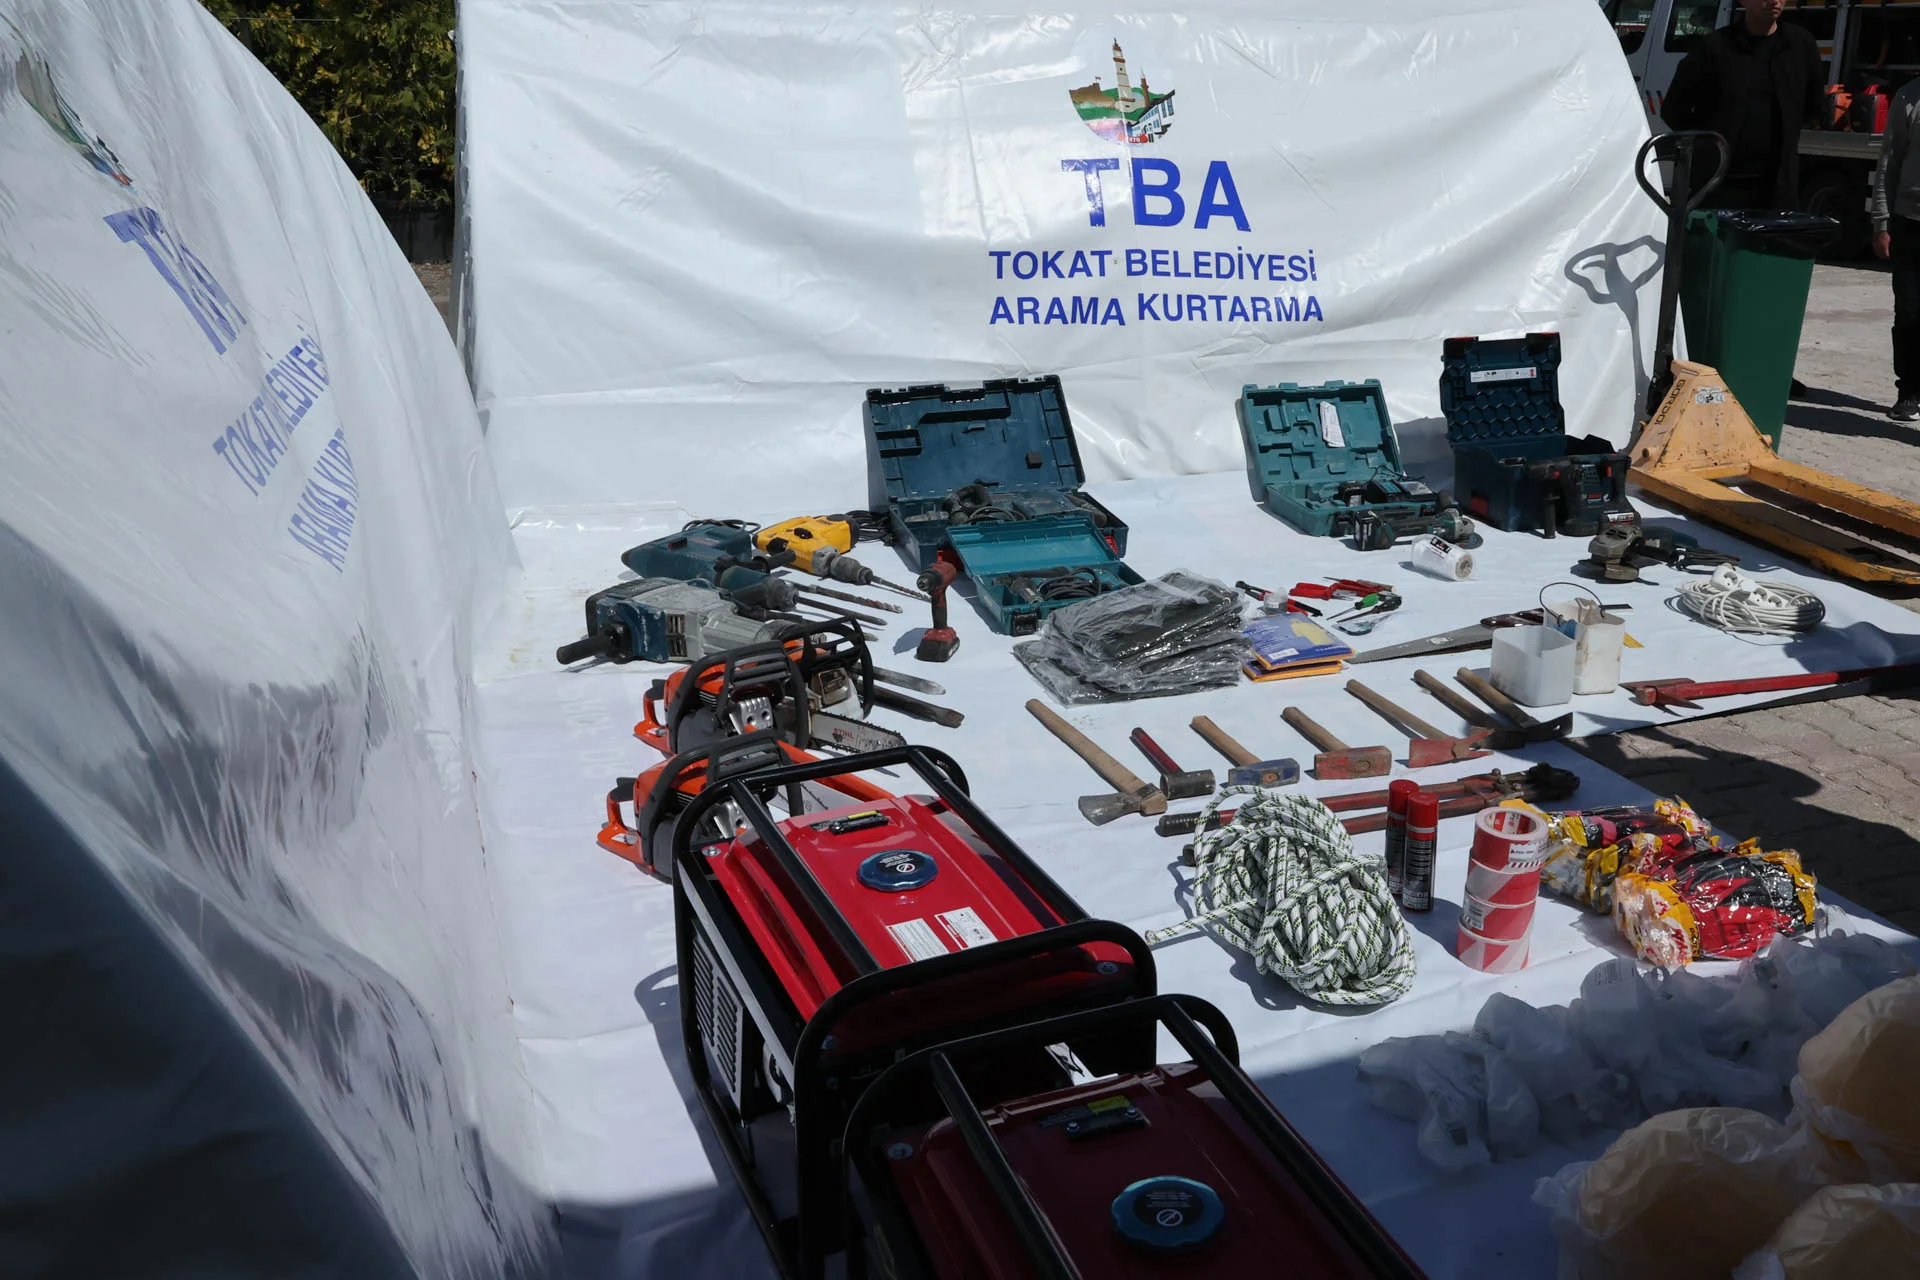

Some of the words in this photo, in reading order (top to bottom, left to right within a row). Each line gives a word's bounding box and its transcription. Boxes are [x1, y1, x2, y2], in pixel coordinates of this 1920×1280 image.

[1061, 157, 1251, 232] TBA
[989, 249, 1113, 280] TOKAT
[1125, 246, 1318, 281] BELEDİYESİ
[989, 295, 1126, 326] ARAMA
[1137, 292, 1324, 323] KURTARMA
[211, 394, 289, 496] TOKAT
[287, 477, 358, 574] ARAMA
[833, 727, 855, 740] STIHL
